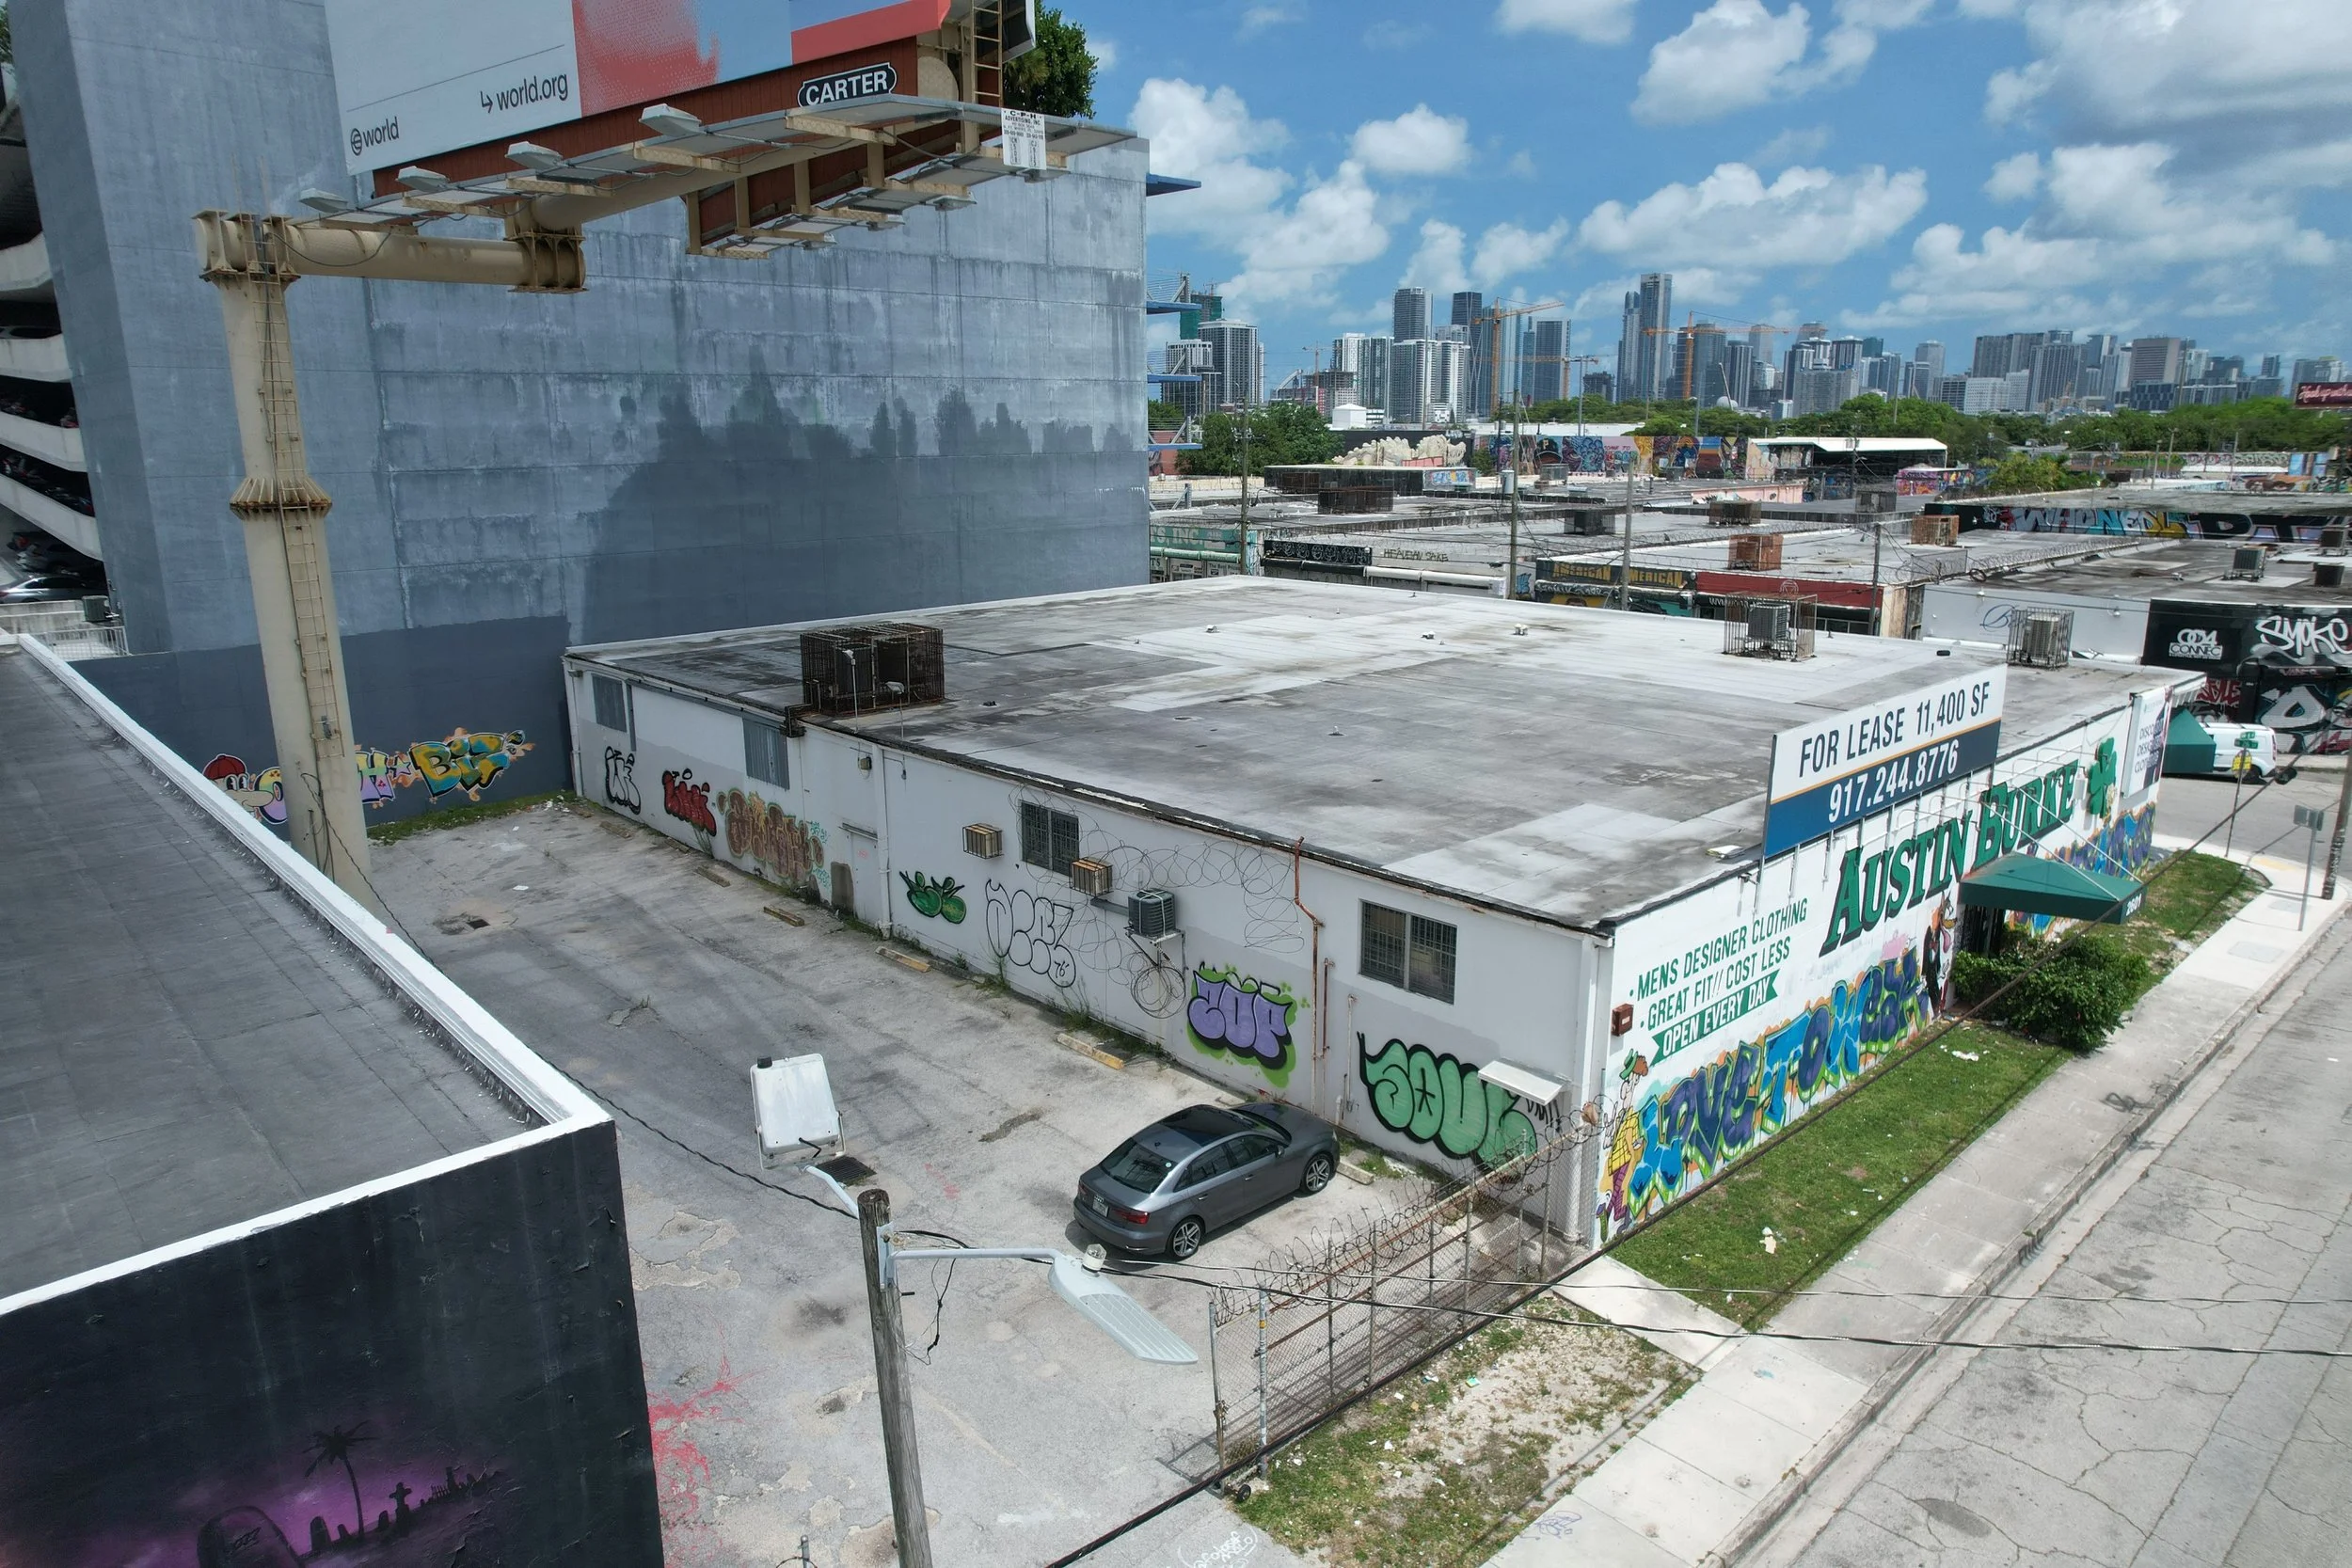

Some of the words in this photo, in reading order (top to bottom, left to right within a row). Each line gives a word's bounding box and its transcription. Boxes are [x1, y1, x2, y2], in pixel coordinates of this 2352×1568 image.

[497, 73, 568, 111] world.org
[805, 70, 888, 105] CARTER
[1553, 562, 1612, 581] AMERICAN
[1629, 568, 1684, 588] MERICAN
[1799, 729, 1839, 778] FOR
[1847, 707, 1905, 760] LEASE
[1916, 689, 1965, 737] 11,400
[1971, 681, 1990, 717] SF
[1828, 738, 1960, 824] 917.244.8776
[1819, 810, 1974, 958] AUSTIN
[1970, 759, 2079, 875] BURKE
[1637, 958, 1678, 1002] MENS
[1683, 925, 1747, 979] DESIGNER
[1752, 897, 1808, 945] CLOTHING
[1647, 986, 1690, 1032] GREAT
[1726, 952, 1757, 990] COST
[1761, 936, 1791, 973] LESS
[1662, 1015, 1701, 1057] OPEN
[1703, 988, 1747, 1036] EVERY
[1747, 974, 1772, 1011] DAY
[1628, 1040, 1762, 1220] LOVE
[1759, 1003, 1832, 1135] TO
